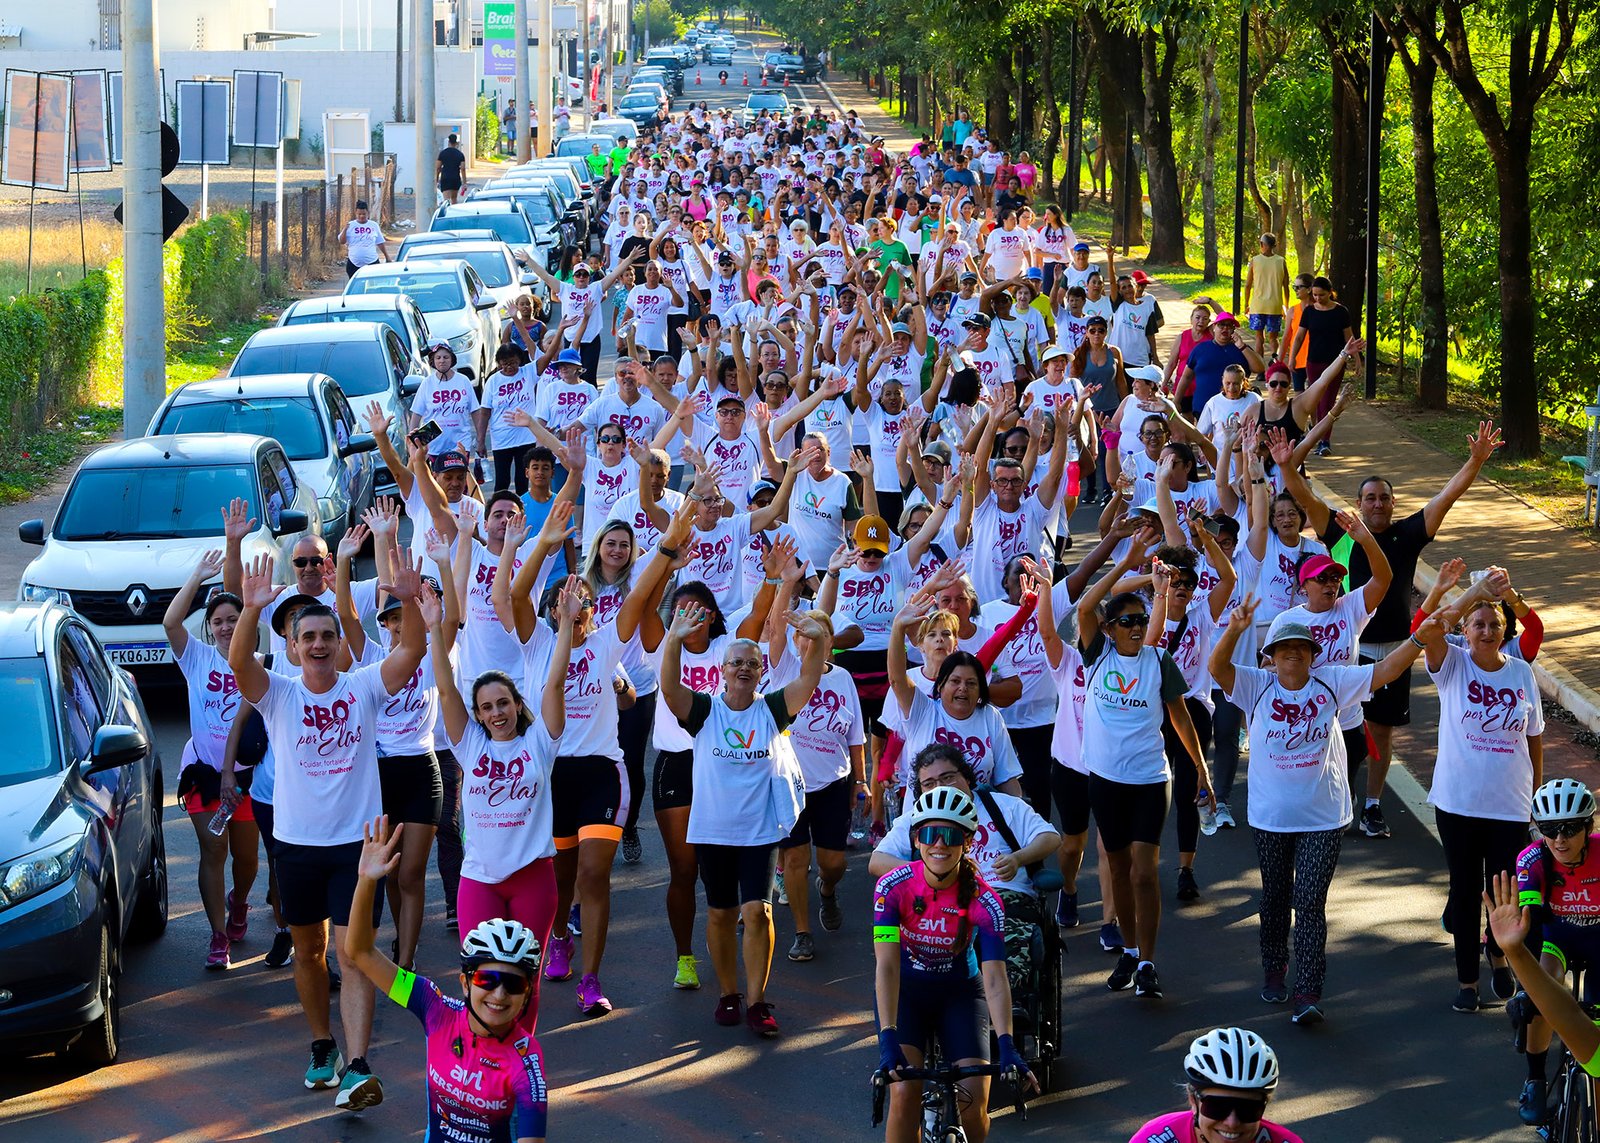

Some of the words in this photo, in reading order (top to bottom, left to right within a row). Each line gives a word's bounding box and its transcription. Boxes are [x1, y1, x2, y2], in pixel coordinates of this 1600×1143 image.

[722, 214, 734, 222] BO
[663, 267, 681, 276] SBO
[569, 291, 589, 301] SBO
[637, 295, 659, 304] SBO
[545, 367, 560, 377] SB
[982, 372, 996, 385] las
[432, 389, 461, 404] SBO
[498, 380, 523, 397] SBO
[558, 392, 587, 405] SBO
[442, 400, 466, 417] Elas
[596, 469, 622, 489] SBO
[805, 491, 825, 509] QV
[814, 510, 832, 519] VIDA
[690, 539, 727, 560] SBO
[476, 562, 506, 584] SB
[702, 553, 733, 580] Elas
[1278, 553, 1296, 577] SB
[842, 576, 884, 598] SBO
[1270, 575, 1286, 586] por
[470, 586, 484, 596] por
[855, 590, 894, 620] Elas
[1308, 622, 1340, 639] BO
[111, 650, 166, 662] FKQ6J37
[1012, 632, 1046, 664] Ela
[206, 669, 238, 694] SB
[1104, 671, 1138, 695] QV
[1093, 687, 1119, 704] QUALI
[1120, 697, 1148, 708] VIDA
[1467, 680, 1517, 708] SBO
[205, 698, 221, 712] por
[302, 698, 349, 731] SBO
[1270, 697, 1318, 724] SBO
[808, 702, 849, 736] Elas
[1461, 709, 1483, 724] por
[1482, 700, 1525, 733] Elas
[296, 734, 317, 751] por
[318, 716, 362, 756] Elas
[724, 727, 756, 749] QV
[935, 726, 985, 758] SBO
[1265, 729, 1287, 744] por
[1286, 714, 1329, 750] Elas
[712, 747, 743, 760] QUALI
[745, 749, 772, 760] VIDA
[815, 746, 836, 754] mulheres
[1291, 751, 1318, 760] fortalecer
[306, 769, 328, 777] inspirar
[328, 765, 353, 775] mulheres
[323, 757, 351, 767] fortalecer
[472, 753, 525, 781] SBO
[1295, 760, 1320, 768] mulheres
[469, 784, 487, 796] por
[488, 773, 538, 807] Elas
[493, 811, 522, 819] fortalecer
[497, 819, 526, 828] mulheres
[975, 842, 1001, 865] las
[875, 864, 912, 894] Bandini
[1562, 889, 1591, 902] avt
[983, 890, 1005, 932] Bandini
[918, 917, 947, 933] avt
[429, 1064, 507, 1111] VERSATRONIC
[450, 1064, 482, 1091] avt
[529, 1053, 547, 1102] Bandini
[439, 1120, 492, 1143] PIRALUX
